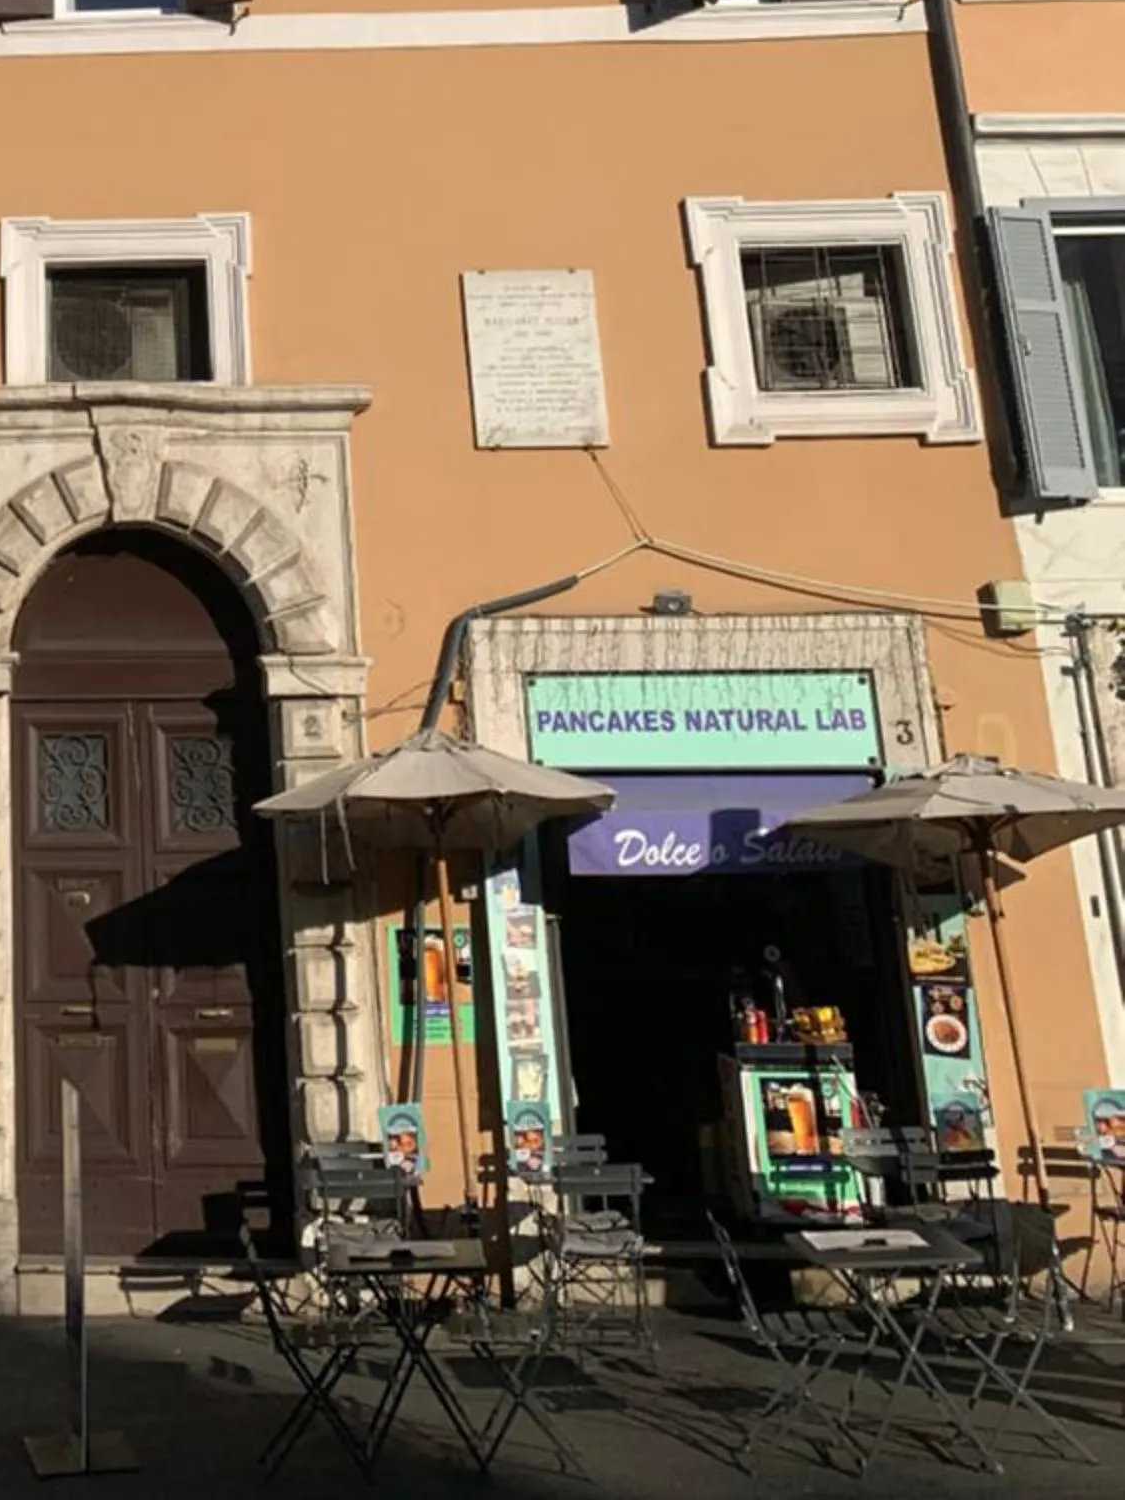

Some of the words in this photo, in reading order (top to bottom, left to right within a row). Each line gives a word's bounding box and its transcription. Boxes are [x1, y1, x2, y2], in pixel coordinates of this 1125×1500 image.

[536, 708, 676, 733] PANCAKES
[684, 708, 808, 733] NATURAL
[815, 707, 868, 731] LAB
[894, 719, 915, 746] 3
[613, 828, 704, 867] Dolce
